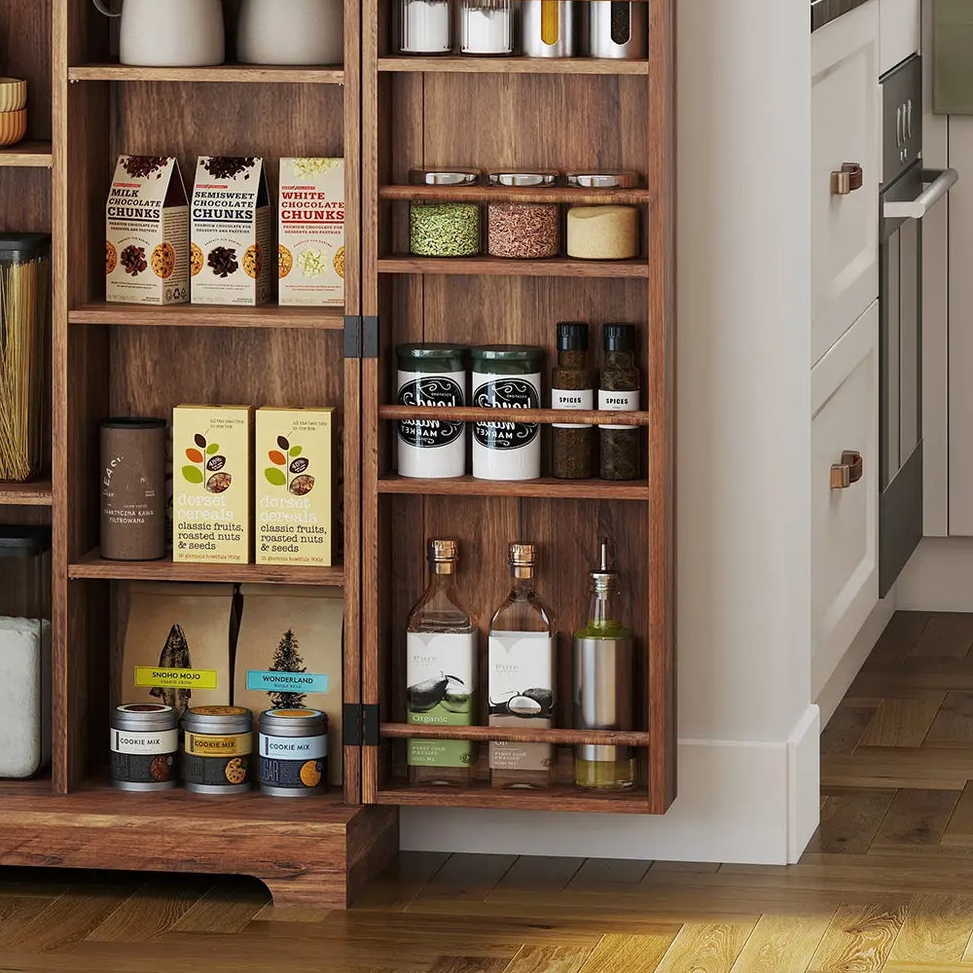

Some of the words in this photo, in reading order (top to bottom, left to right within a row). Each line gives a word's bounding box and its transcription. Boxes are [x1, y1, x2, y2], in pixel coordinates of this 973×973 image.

[111, 188, 139, 197] MILK
[194, 191, 255, 200] SEMISWEET
[281, 192, 325, 200] WHITE
[108, 198, 162, 207] CHOCOLATE
[193, 200, 254, 208] CHOCOLATE
[281, 201, 345, 209] CHOCOLATE
[107, 207, 160, 219] CHUNKS
[193, 208, 253, 219] CHUNKS
[281, 210, 345, 220] CHUNKS
[178, 494, 227, 507] dorset
[260, 495, 311, 508] dorset
[178, 508, 234, 520] cereals
[260, 509, 317, 522] cereals
[178, 522, 212, 530] classic
[213, 522, 244, 532] fruits,
[260, 524, 294, 533] classic
[296, 525, 327, 535] fruits,
[178, 532, 215, 540] roasted
[217, 533, 241, 541] nuts
[260, 534, 298, 543] roasted
[300, 536, 324, 544] nuts
[178, 541, 187, 549] &
[188, 542, 216, 550] seeds
[260, 543, 270, 552] &
[271, 544, 299, 553] seeds
[262, 675, 314, 684] WONDERLAND
[412, 715, 448, 724] Organic
[120, 738, 145, 746] COOKIE
[269, 743, 296, 751] COOKIE
